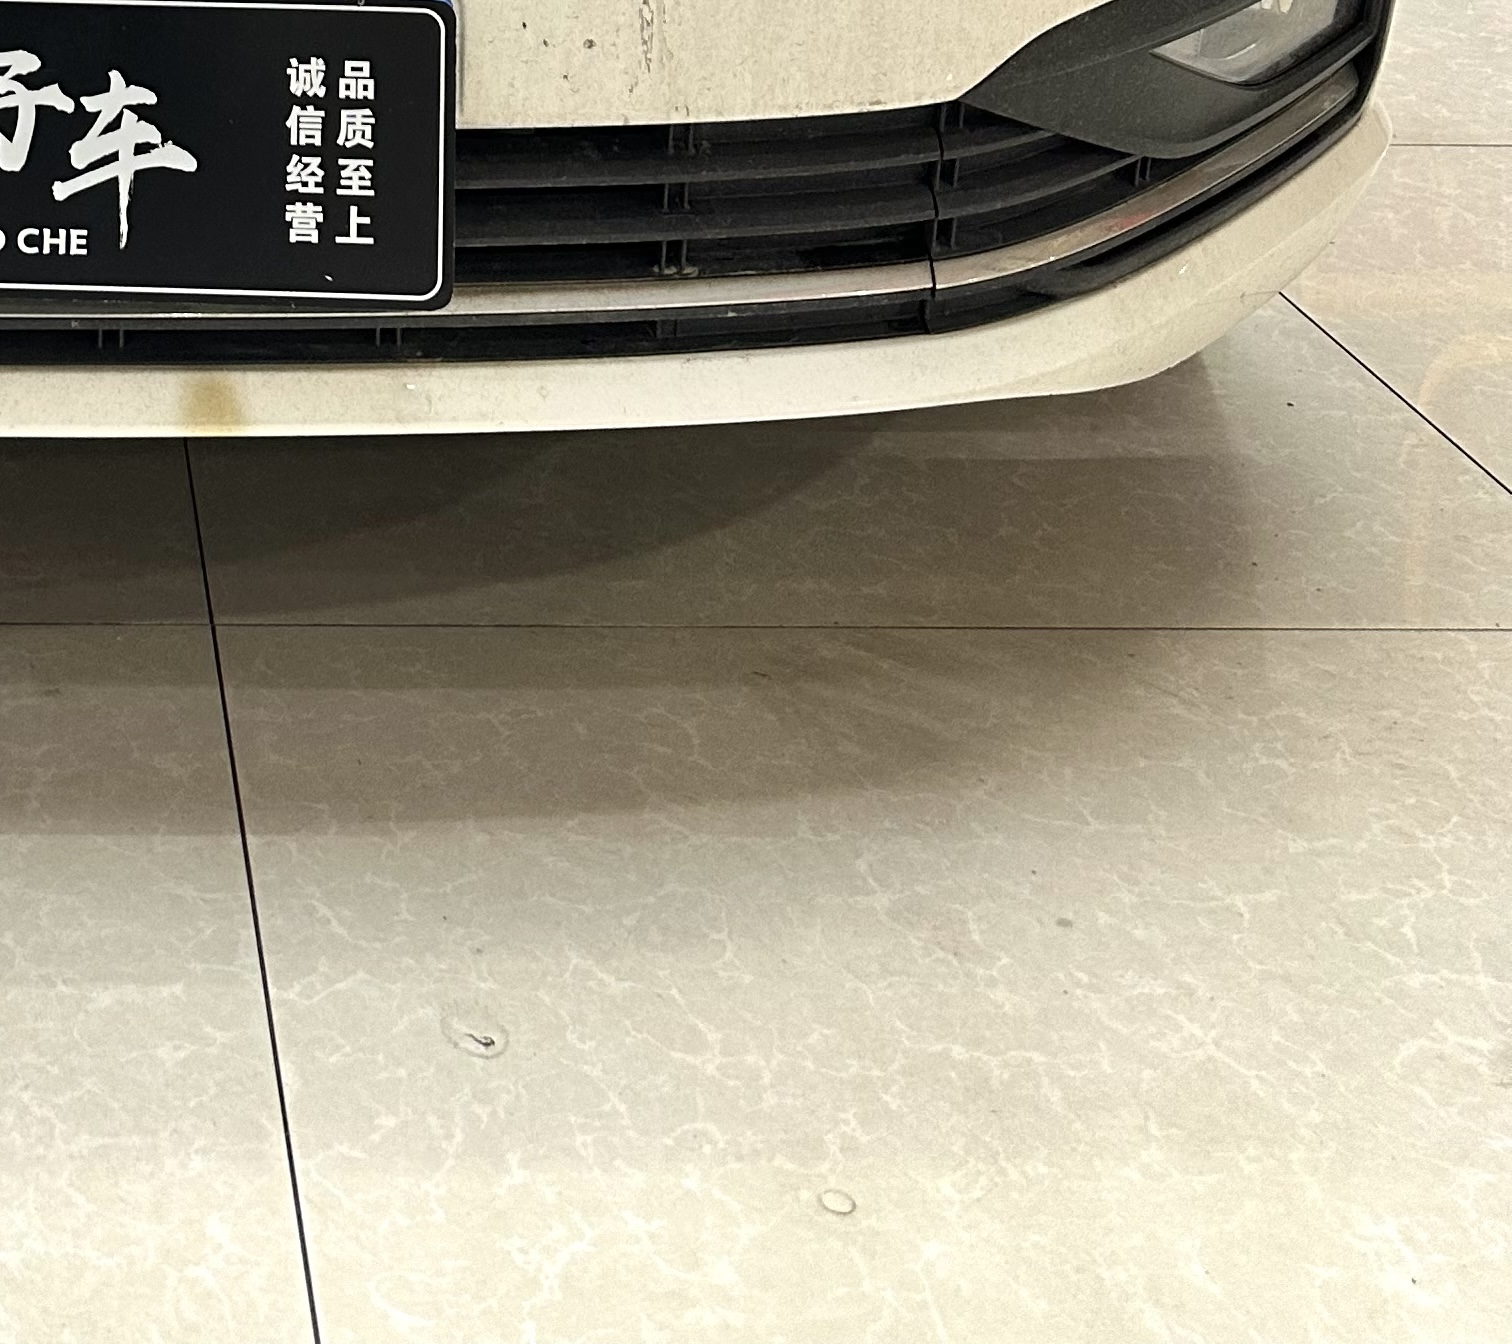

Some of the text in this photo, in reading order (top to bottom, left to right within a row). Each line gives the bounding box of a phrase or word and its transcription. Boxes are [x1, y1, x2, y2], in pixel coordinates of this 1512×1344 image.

[16, 227, 88, 256] CHE
[284, 56, 327, 244] 诚信经营
[334, 59, 376, 245] 品质至上
